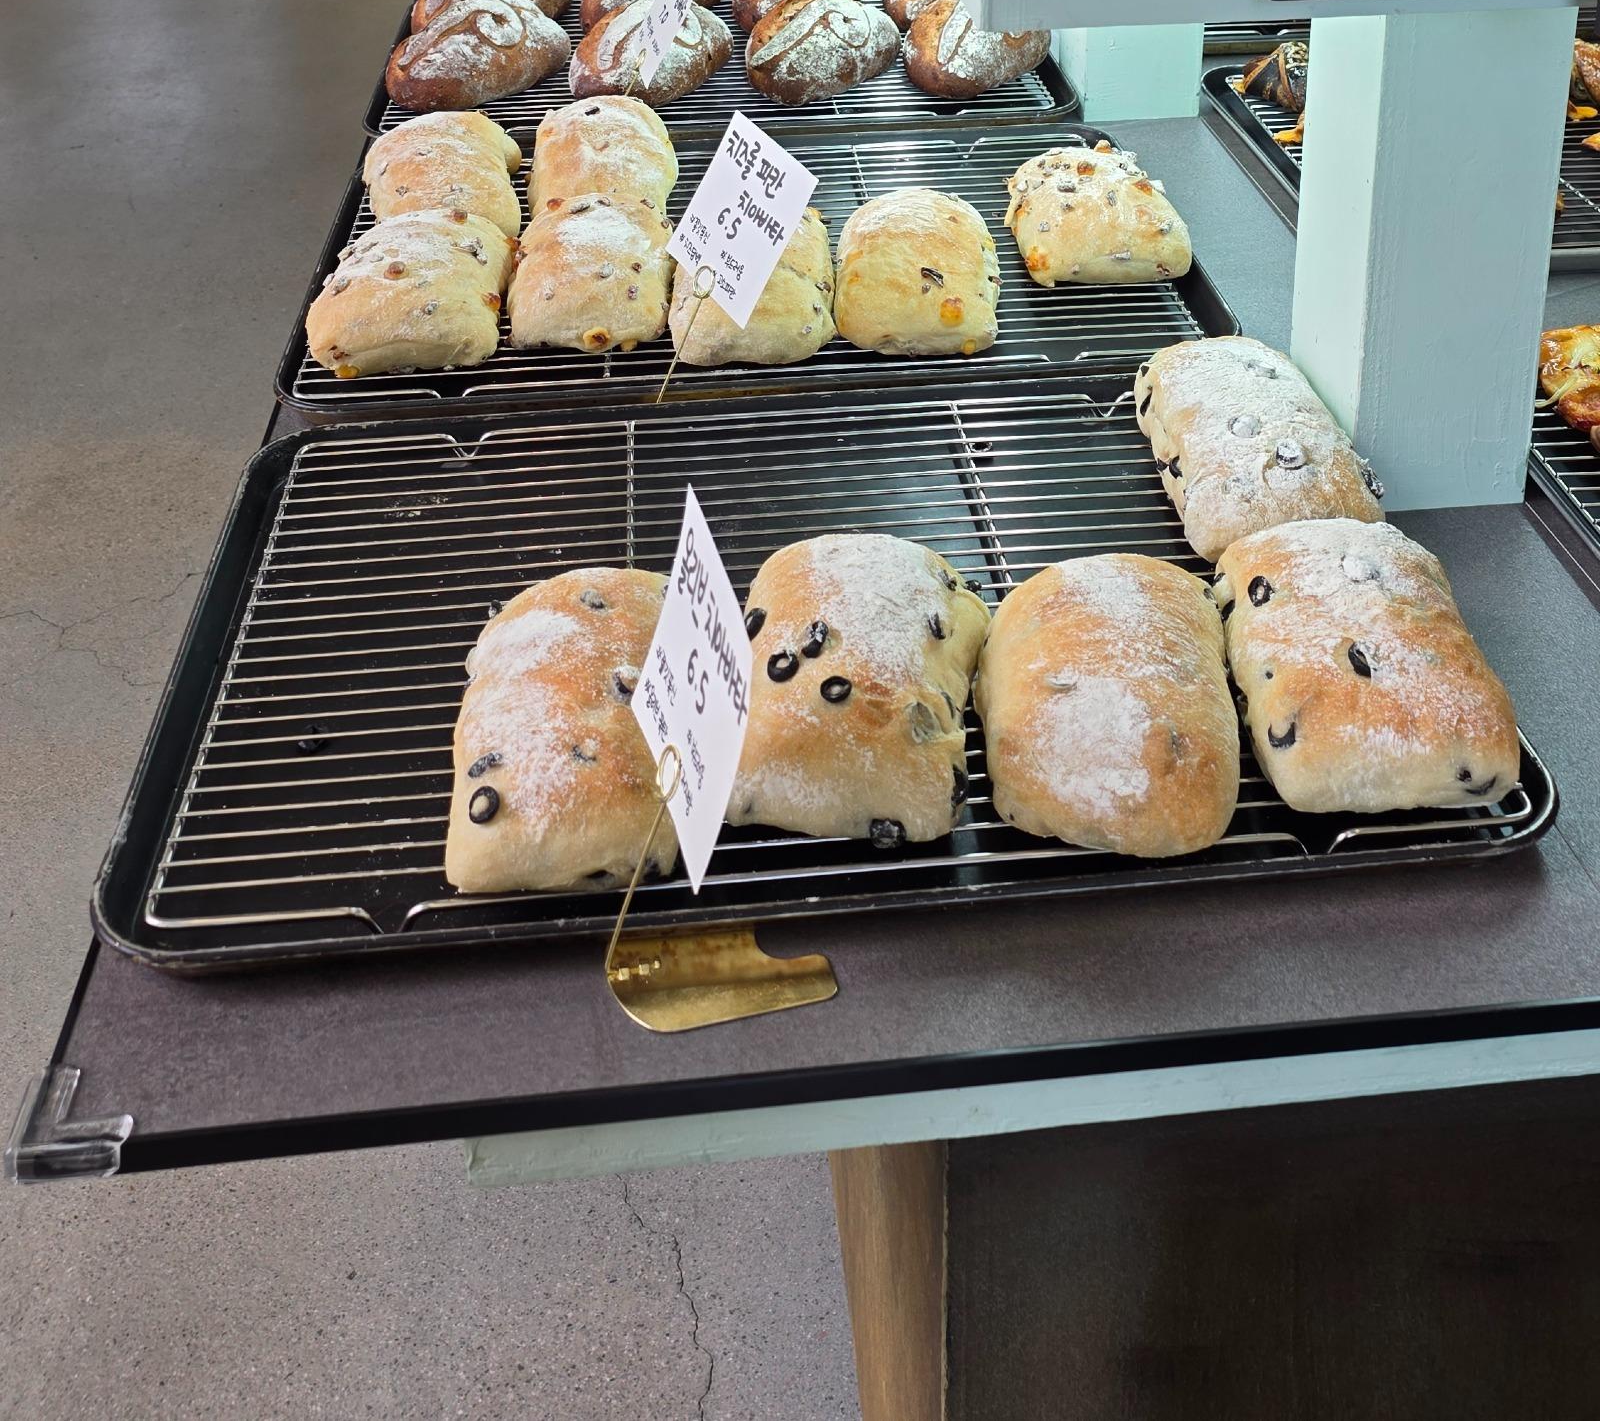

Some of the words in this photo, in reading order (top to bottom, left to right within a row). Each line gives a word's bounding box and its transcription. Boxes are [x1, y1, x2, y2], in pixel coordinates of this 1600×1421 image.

[717, 207, 742, 240] 6.5
[737, 190, 785, 246] 치아바타
[677, 527, 709, 629] 올리브
[705, 590, 747, 726] 치아바타
[687, 648, 709, 715] 6.5
